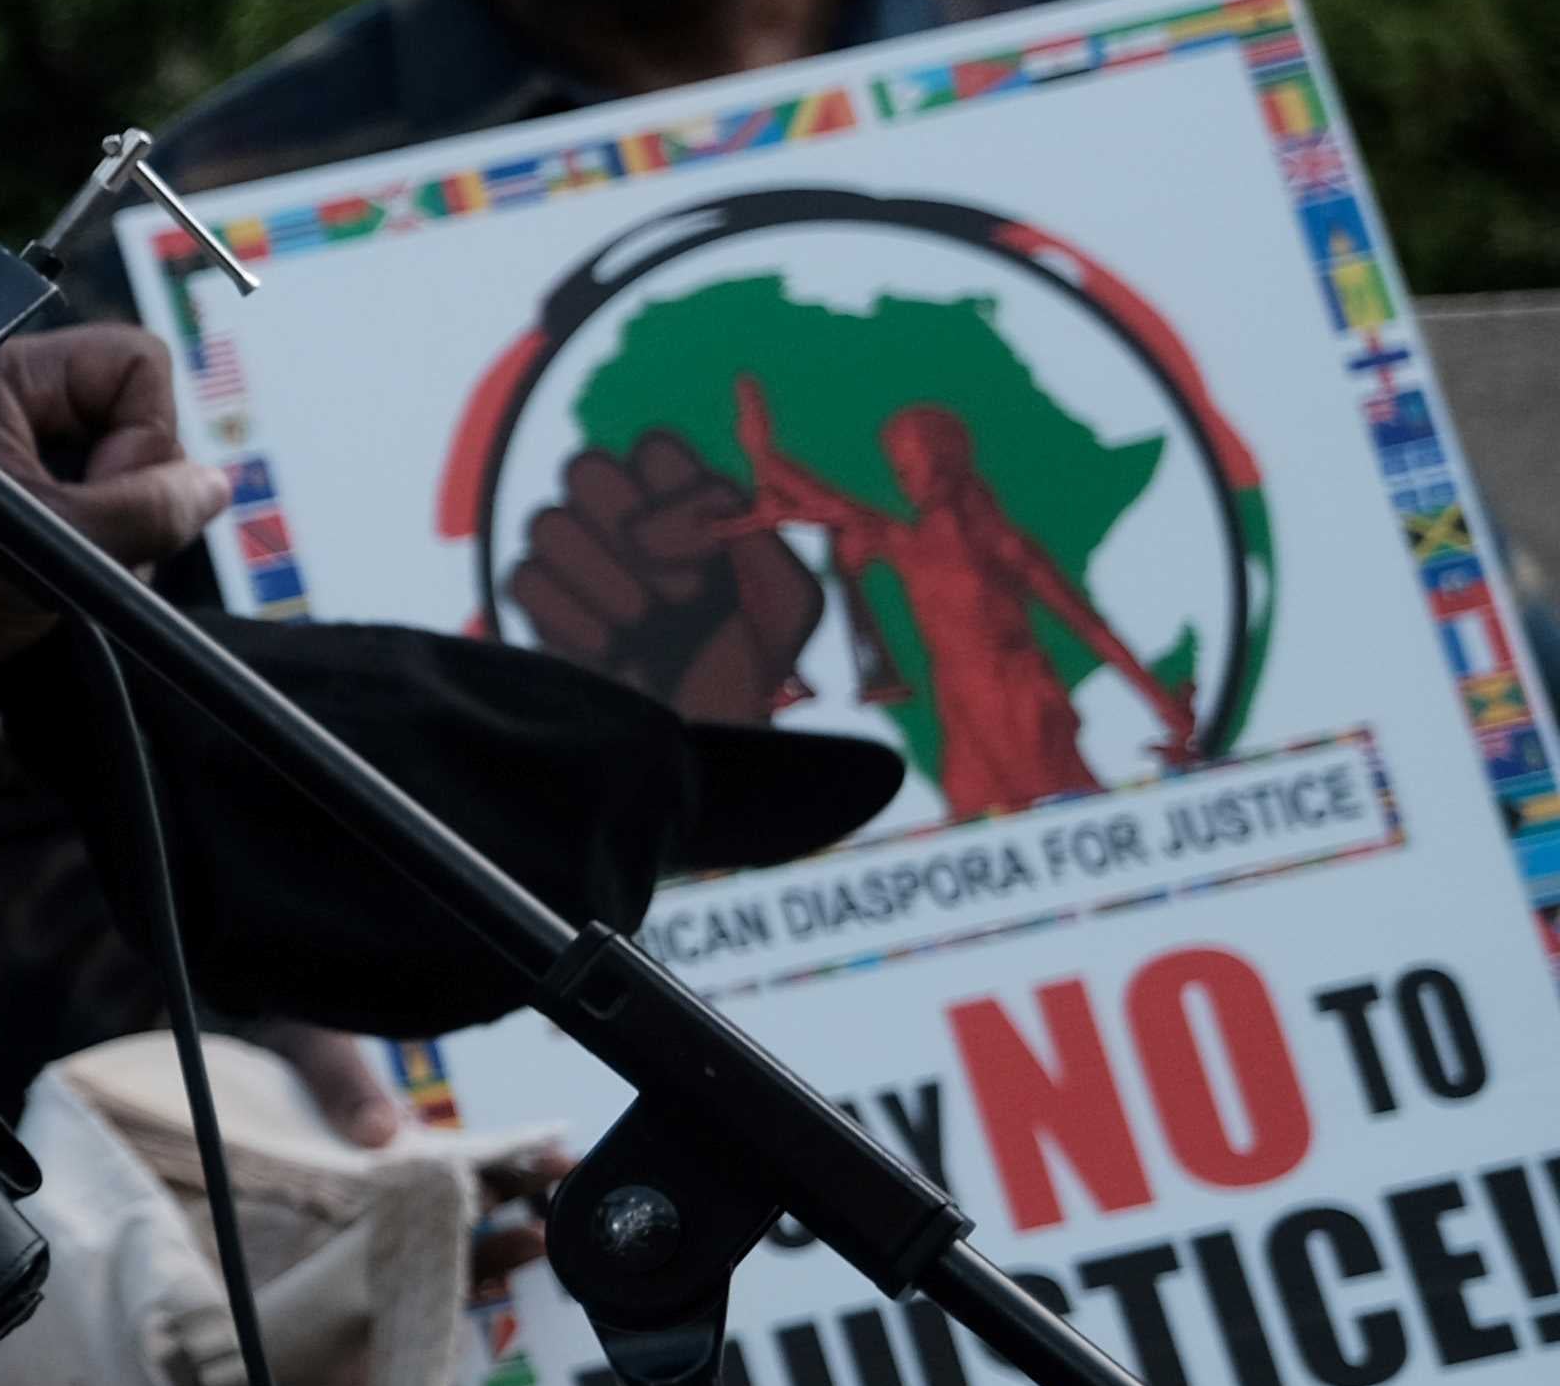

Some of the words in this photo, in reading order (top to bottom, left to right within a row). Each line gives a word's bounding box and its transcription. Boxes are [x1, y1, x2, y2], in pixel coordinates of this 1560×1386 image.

[642, 901, 770, 964] ICAN
[779, 843, 1035, 940] DIASPORA
[1041, 814, 1147, 880] FOR
[1162, 763, 1365, 857] JUSTICE
[945, 945, 1312, 1235] NO
[1312, 964, 1490, 1117] TO
